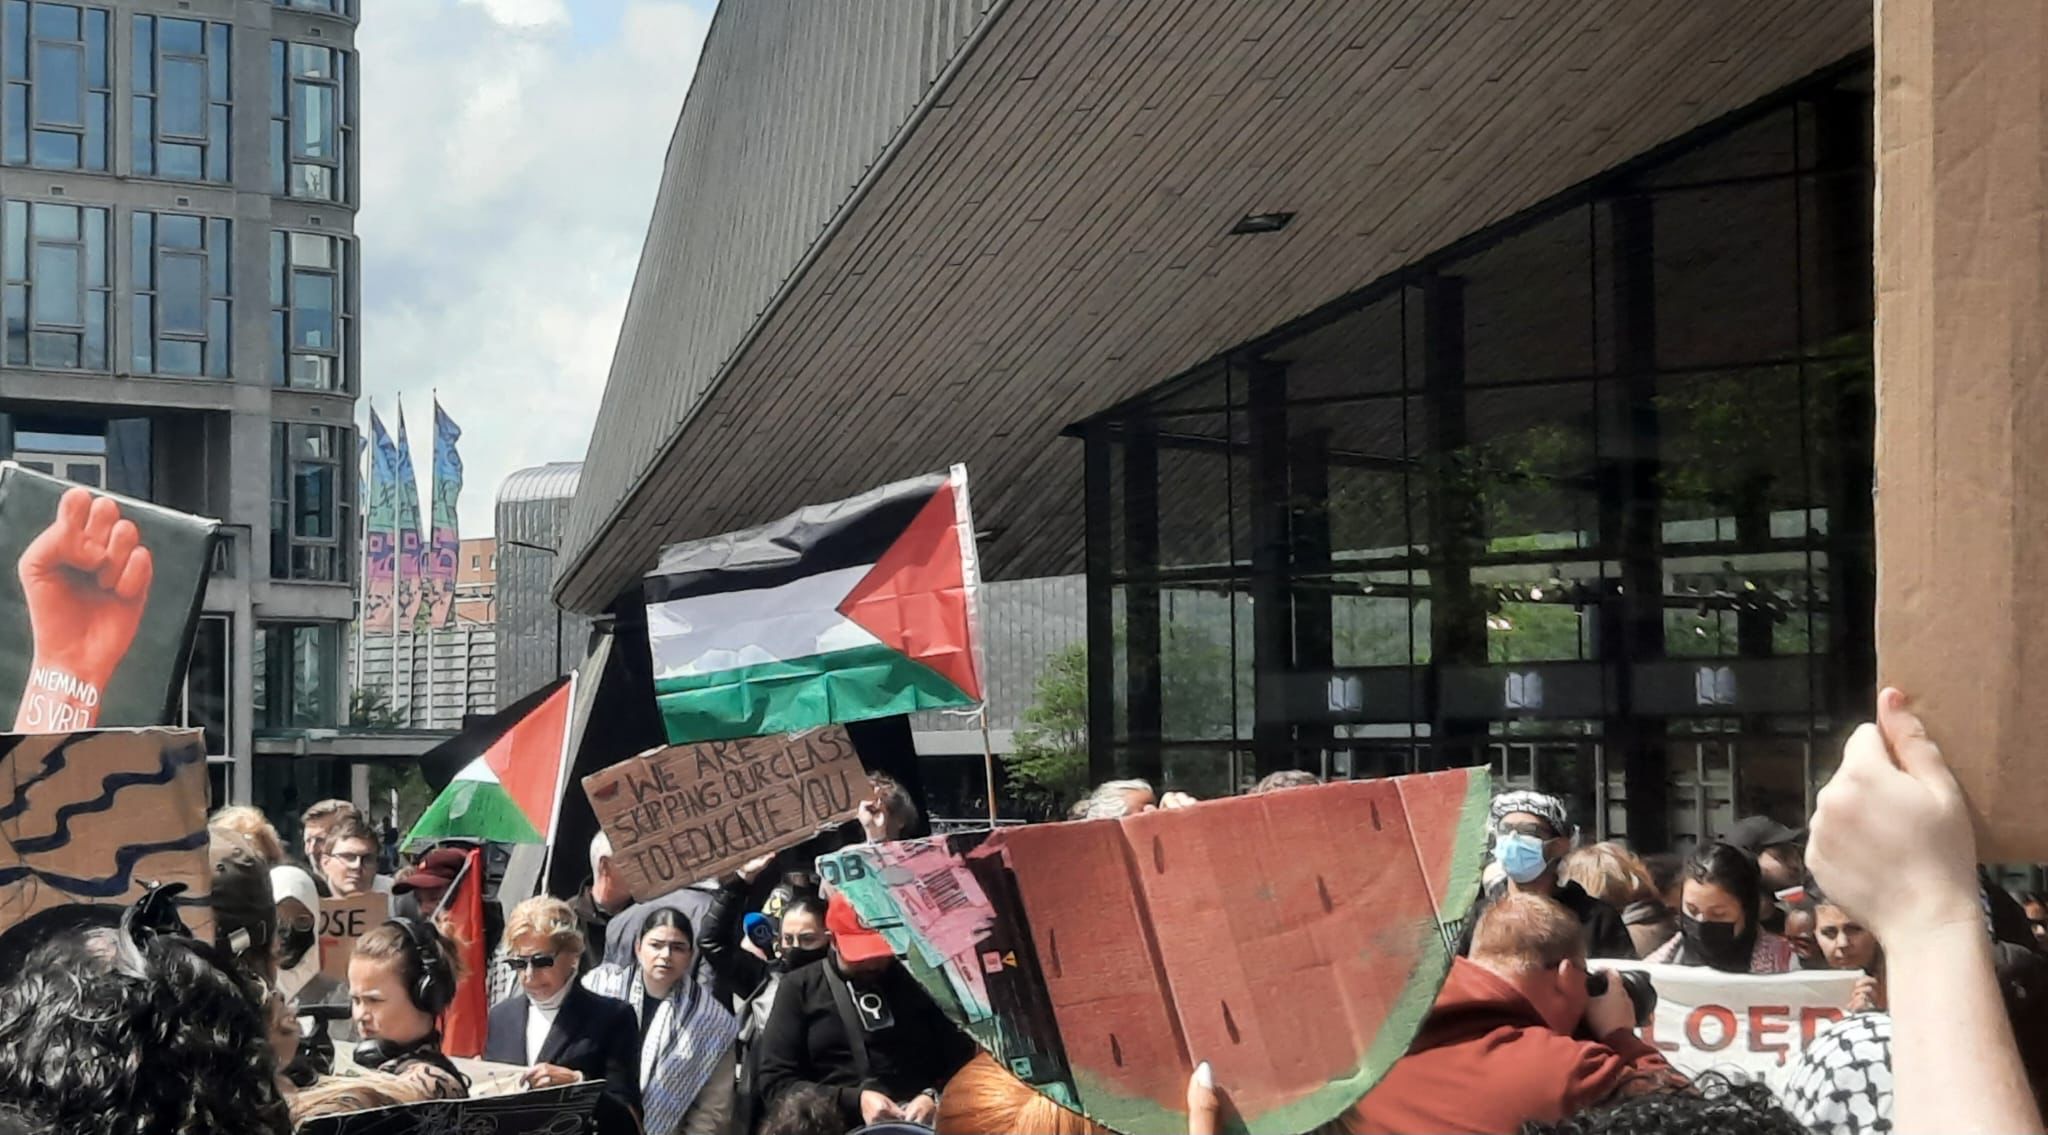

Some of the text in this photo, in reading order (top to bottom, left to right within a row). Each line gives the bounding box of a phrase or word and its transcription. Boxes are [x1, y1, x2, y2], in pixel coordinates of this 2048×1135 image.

[27, 693, 46, 726] IS
[33, 666, 98, 707] NIEMAND
[613, 730, 855, 849] SKIPPING OUR CLASS
[624, 739, 760, 804] WE ARE
[633, 770, 851, 884] TO EDUCATE YOU
